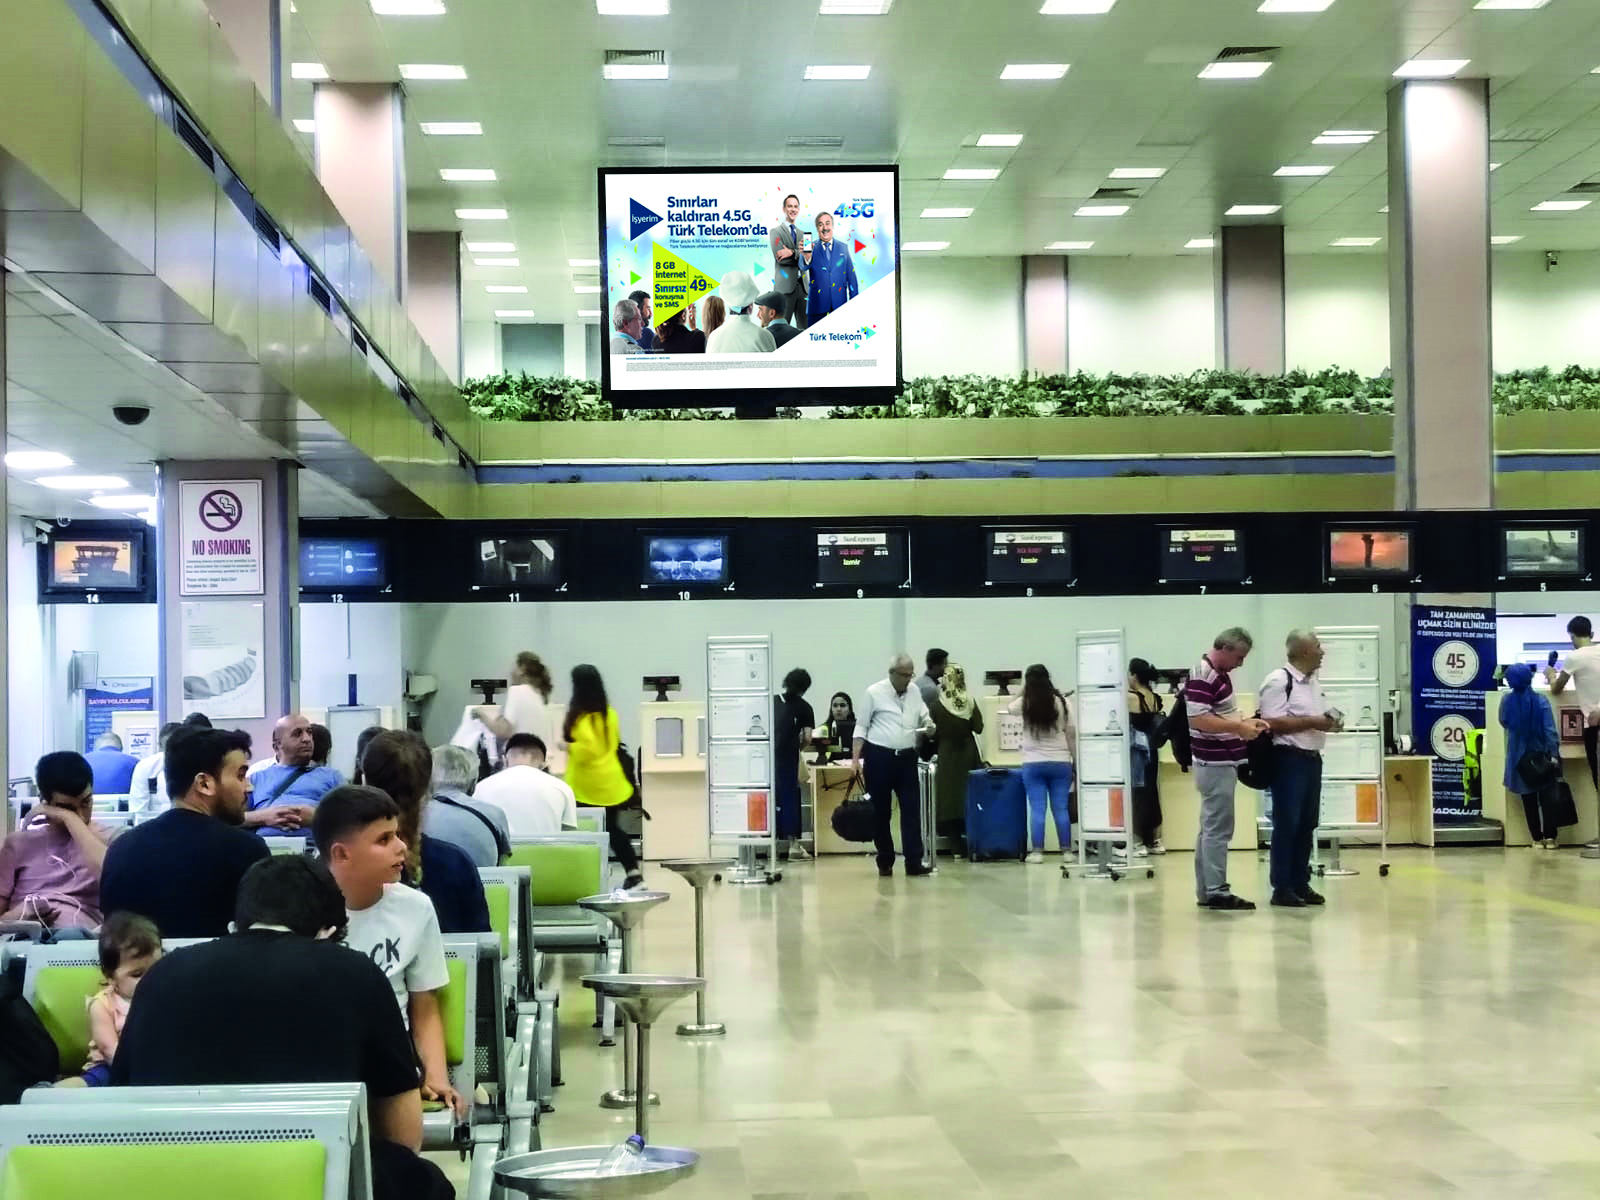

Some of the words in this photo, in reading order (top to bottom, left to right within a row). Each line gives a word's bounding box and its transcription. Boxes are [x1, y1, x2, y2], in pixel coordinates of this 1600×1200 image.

[667, 196, 718, 208] Sınırları
[668, 210, 720, 222] kaldıran
[722, 210, 751, 221] 4.5G
[668, 224, 695, 236] Türk
[655, 284, 687, 293] Sınırsız
[690, 279, 707, 291] 49
[809, 333, 827, 341] Türk
[828, 333, 863, 341] Telekom
[192, 540, 205, 555] NO
[208, 539, 251, 555] SMOKING
[1200, 586, 1206, 594] 7
[1372, 584, 1378, 592] 6
[1540, 583, 1546, 591] 5
[678, 591, 690, 600] 10
[857, 589, 863, 598] 9
[1027, 588, 1033, 596] 8
[86, 594, 99, 603] 14
[331, 594, 343, 603] 12
[509, 593, 520, 602] 11
[1446, 653, 1466, 668] 45
[1443, 727, 1464, 742] 20
